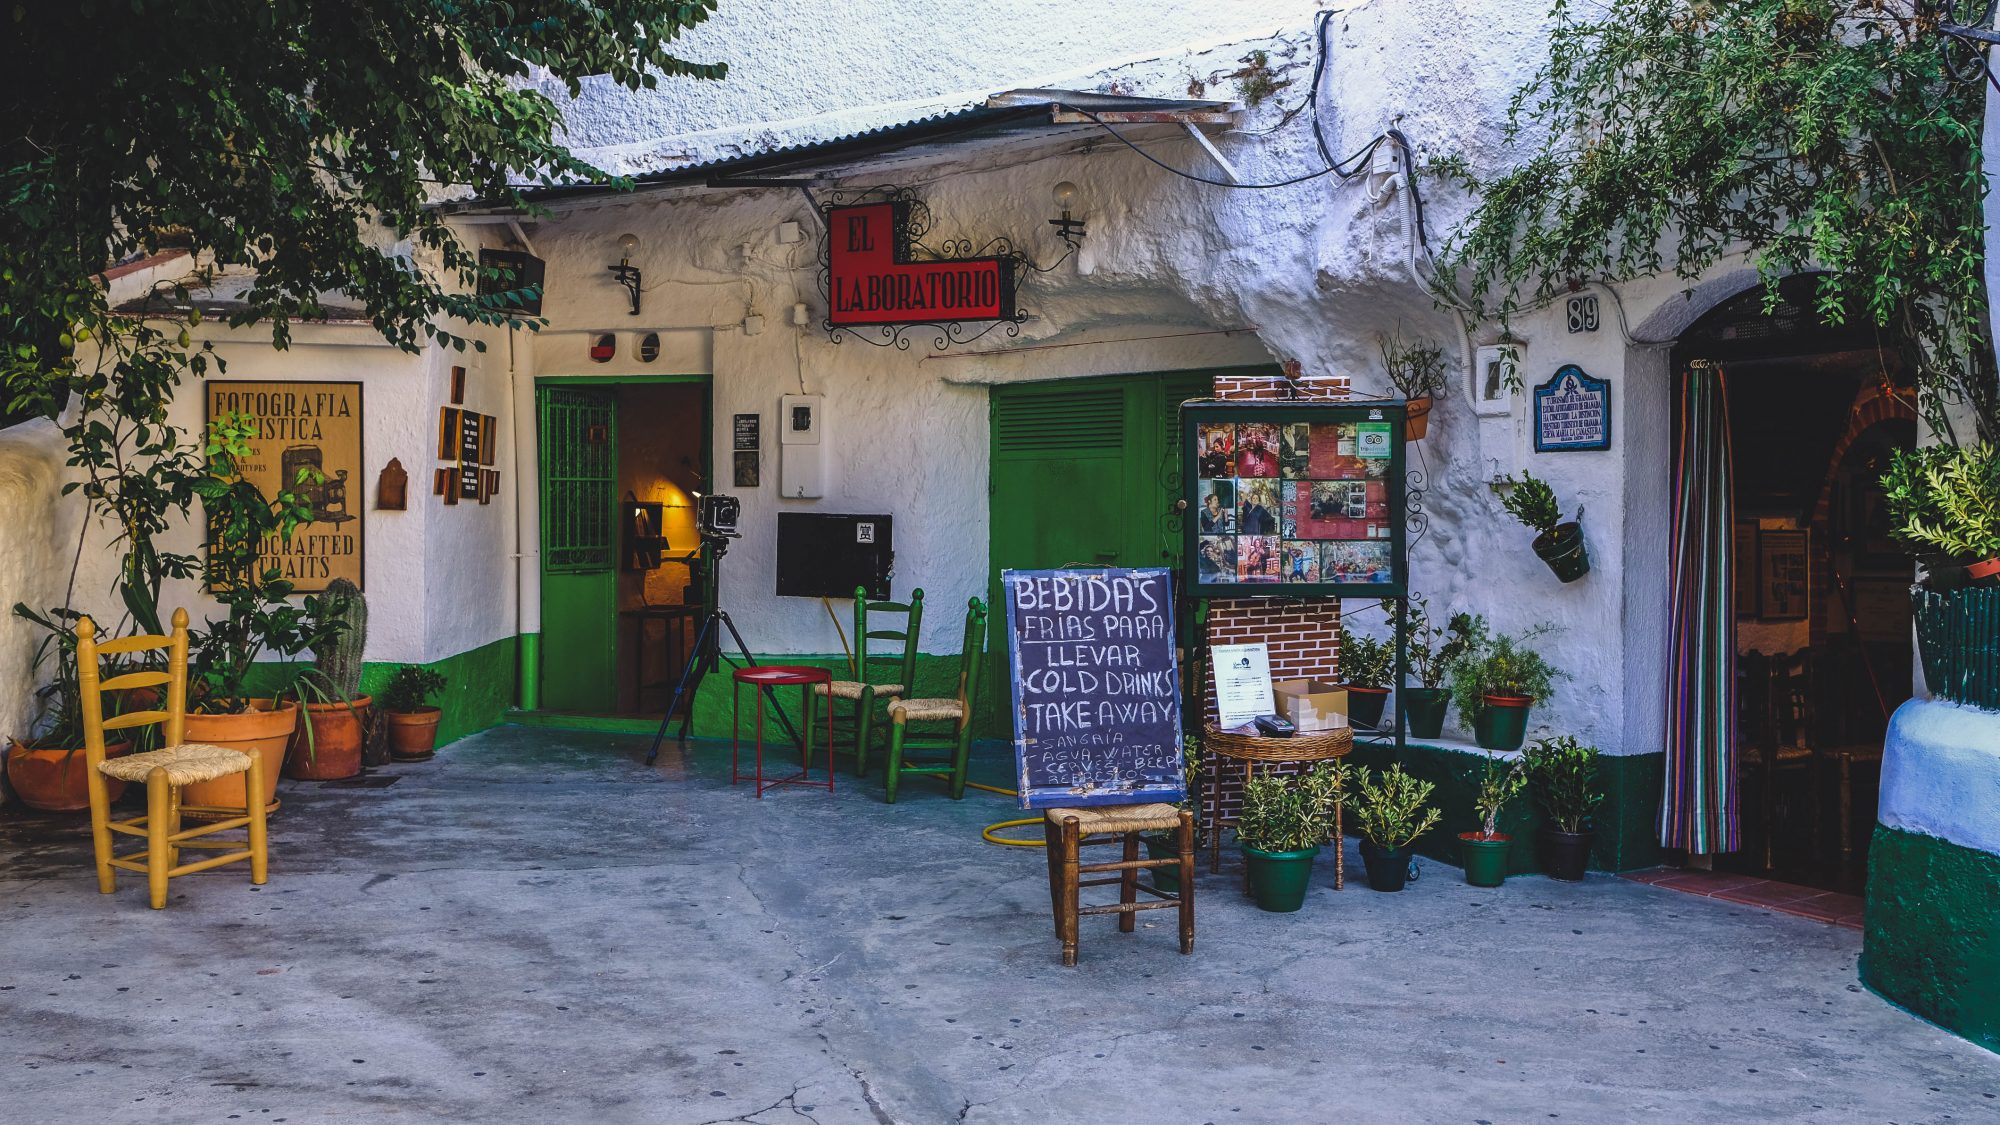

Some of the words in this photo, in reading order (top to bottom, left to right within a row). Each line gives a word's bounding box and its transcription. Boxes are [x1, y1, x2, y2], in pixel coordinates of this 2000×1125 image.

[846, 215, 874, 253] EL
[835, 269, 996, 312] LABORATORIO
[1568, 298, 1598, 331] 89
[215, 392, 352, 417] FOTOGRAFIA
[1103, 615, 1164, 640] PARA
[1048, 645, 1141, 667] LLEVAR
[1026, 668, 1099, 694] COLD
